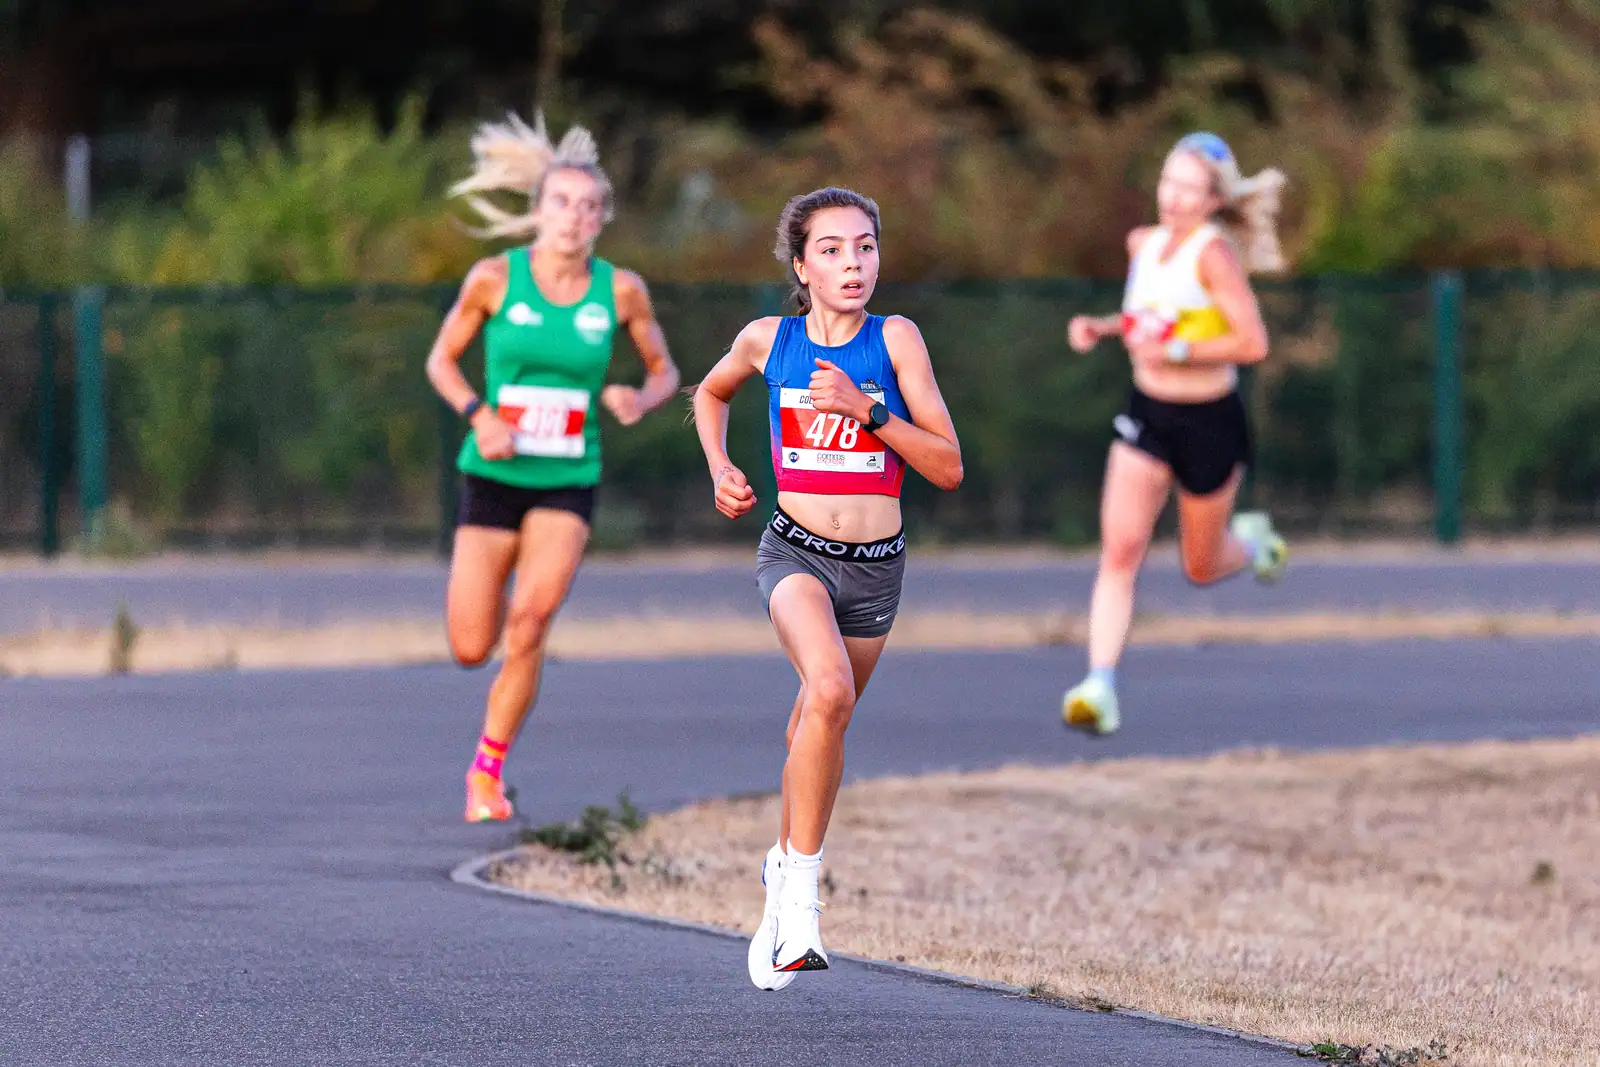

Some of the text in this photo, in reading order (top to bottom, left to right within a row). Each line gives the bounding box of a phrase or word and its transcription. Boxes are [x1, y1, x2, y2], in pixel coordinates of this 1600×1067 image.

[799, 395, 813, 405] COL
[806, 412, 861, 450] 478
[786, 525, 848, 555] PRO
[853, 532, 905, 558] NIKE
